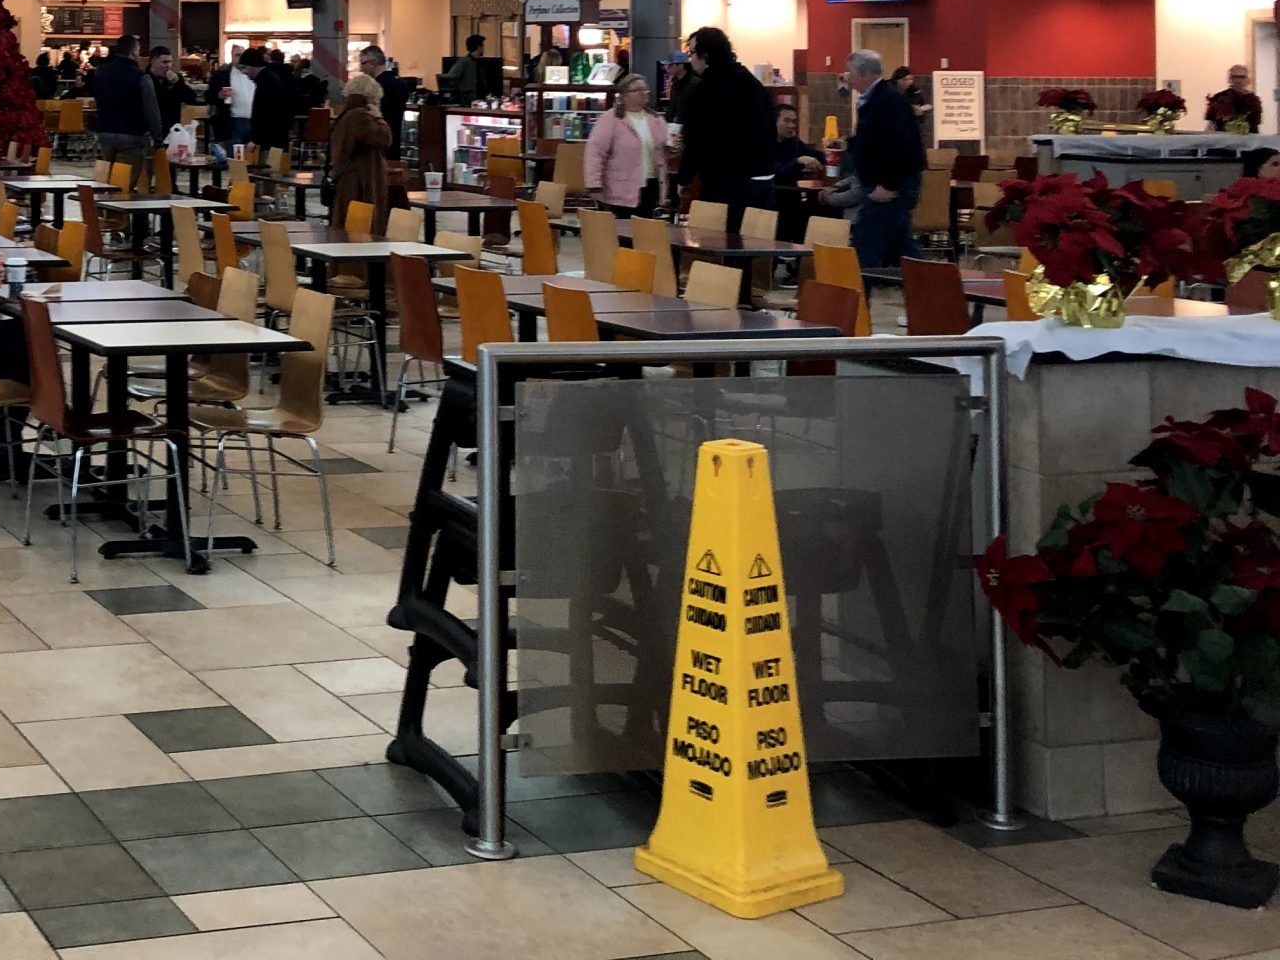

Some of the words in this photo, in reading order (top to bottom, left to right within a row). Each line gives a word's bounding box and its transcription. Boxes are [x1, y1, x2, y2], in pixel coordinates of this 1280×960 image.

[940, 77, 975, 86] CLOSED
[688, 577, 727, 605] CAUTION
[743, 584, 779, 607] CAUTION
[686, 604, 727, 633] CUIDADO
[744, 611, 782, 635] CUIDADO
[691, 649, 722, 676] WET
[752, 657, 781, 680] WET
[682, 673, 728, 705] FLOOR
[747, 683, 790, 708] FLOOR
[686, 715, 720, 745] PISO
[756, 726, 788, 751] PISO
[672, 737, 732, 778] MOJADO
[746, 751, 802, 781] MOJADO
